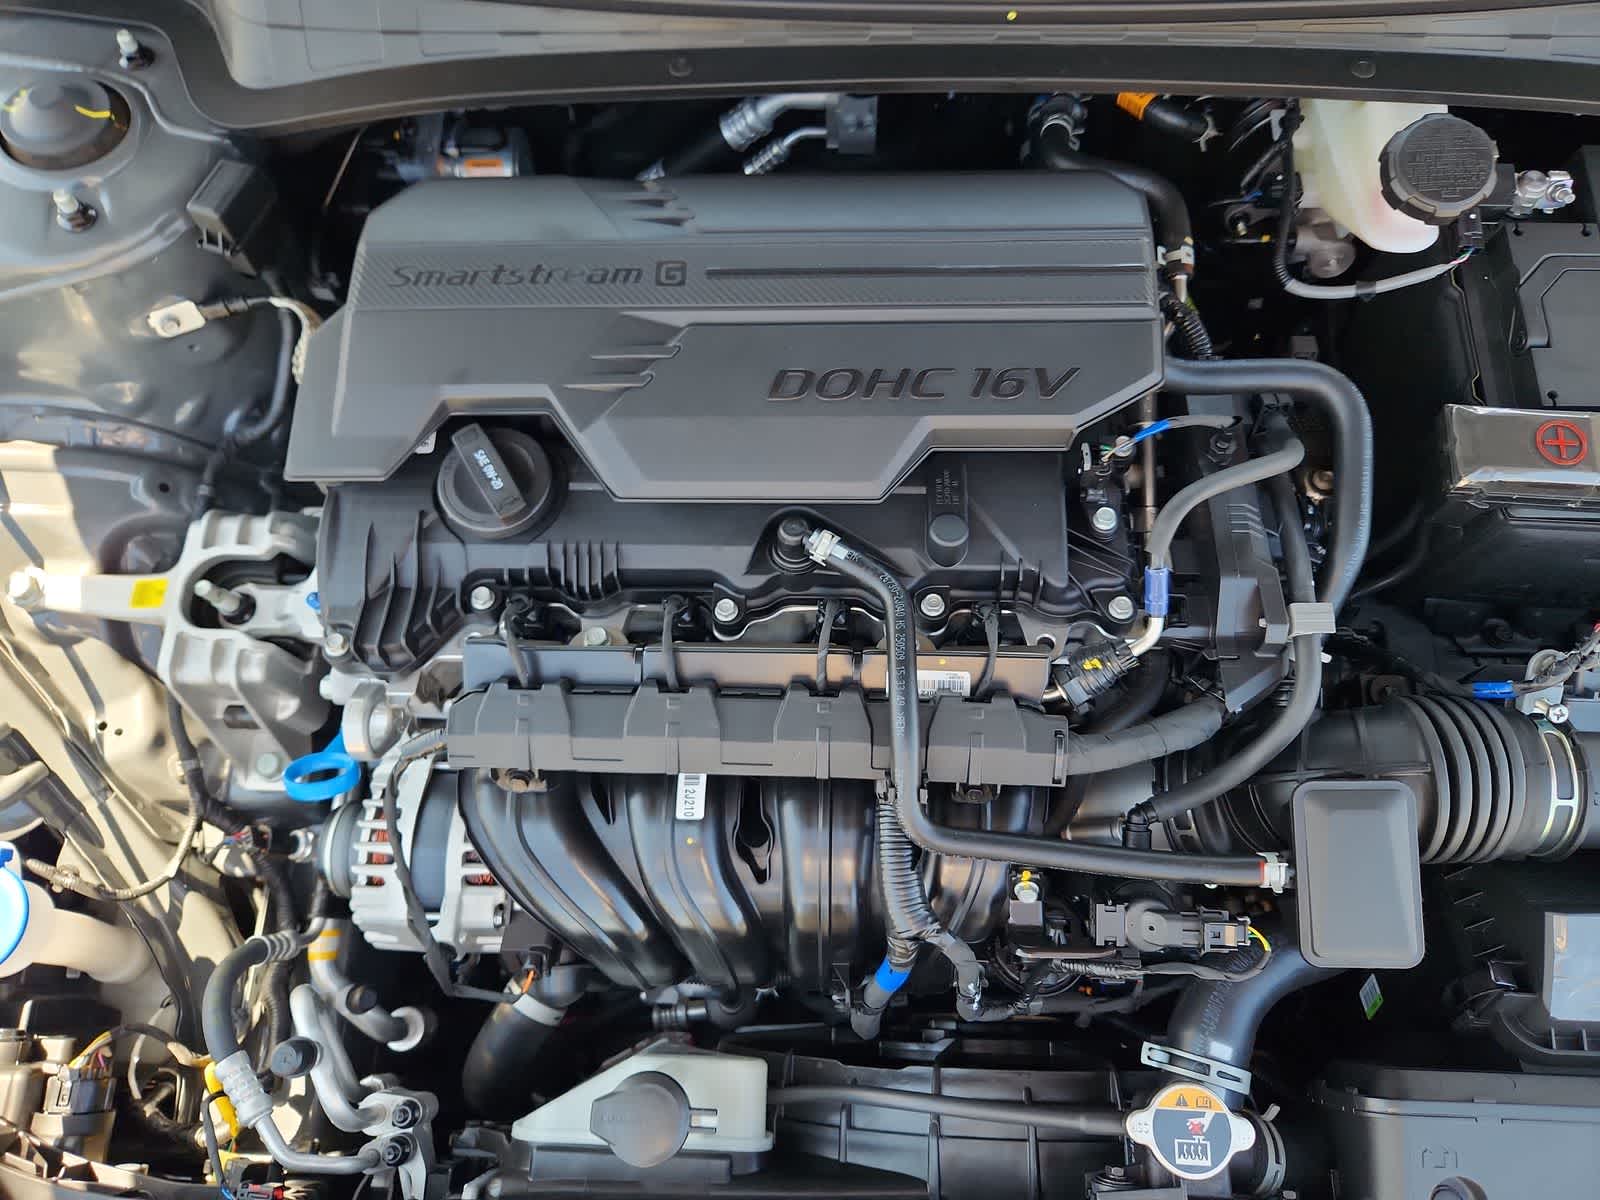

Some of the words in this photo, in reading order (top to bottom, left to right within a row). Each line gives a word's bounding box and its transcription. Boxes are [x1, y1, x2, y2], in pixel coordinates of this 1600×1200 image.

[388, 264, 643, 288] Smartstream
[767, 367, 957, 400] DOHC
[969, 367, 1081, 399] 16V
[473, 448, 490, 467] SAE
[483, 463, 503, 490] 0W-20
[683, 788, 697, 817] 2J210
